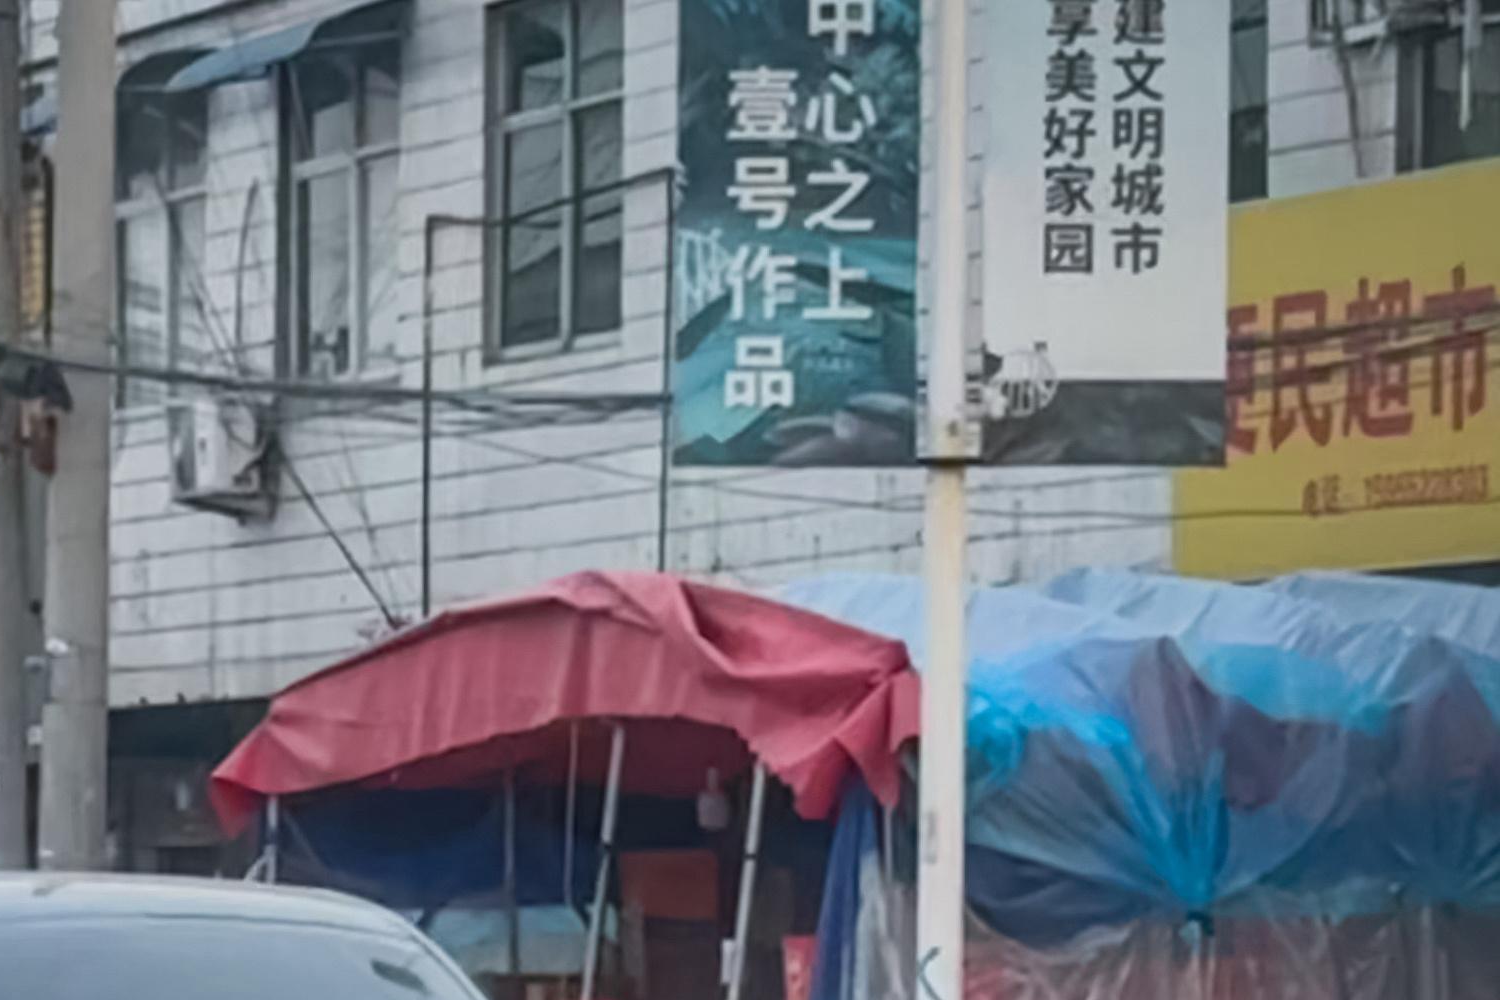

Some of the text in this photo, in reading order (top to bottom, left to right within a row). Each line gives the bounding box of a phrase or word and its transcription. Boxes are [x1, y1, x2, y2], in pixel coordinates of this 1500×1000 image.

[724, 65, 798, 408] 壹号作品
[1110, 0, 1165, 274] 建文明城市
